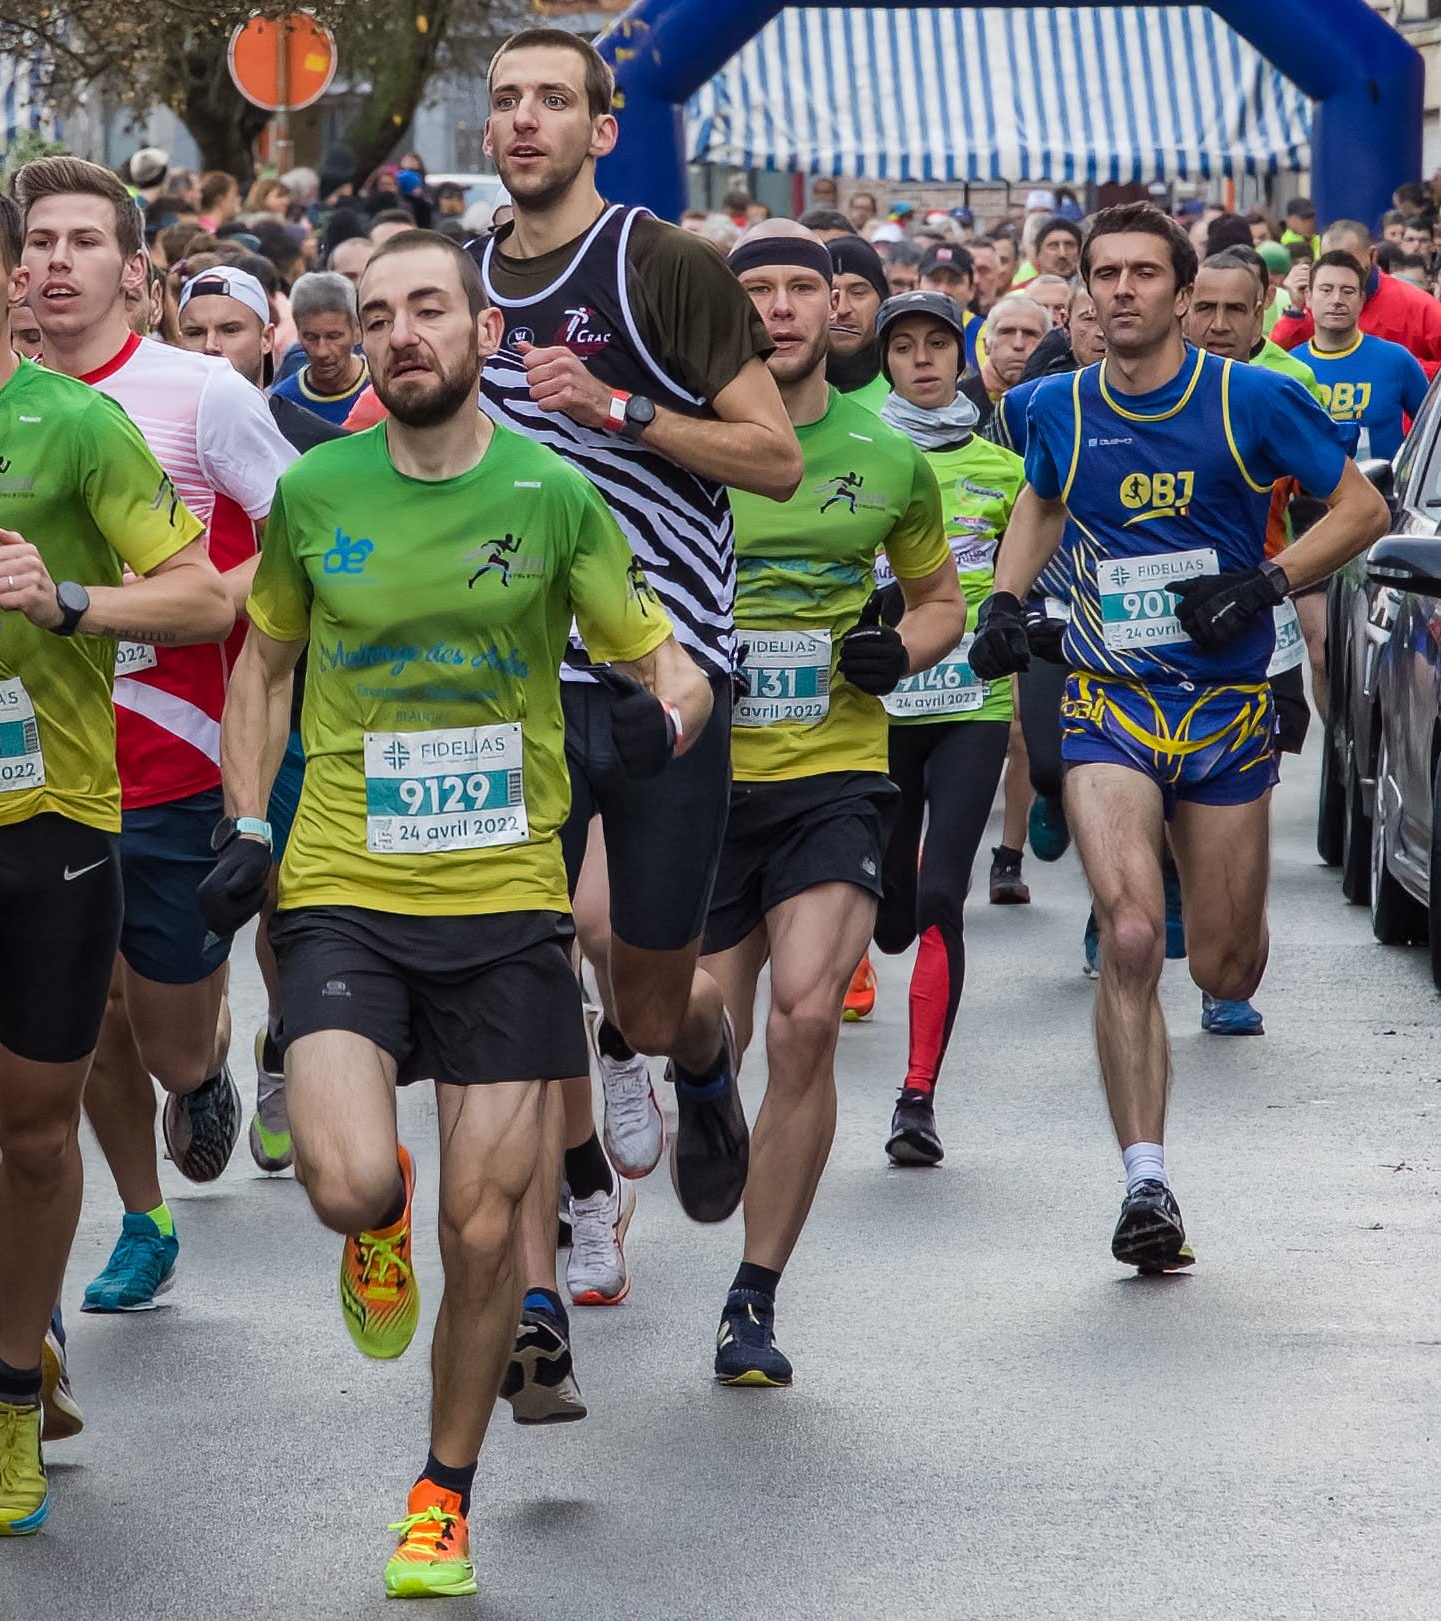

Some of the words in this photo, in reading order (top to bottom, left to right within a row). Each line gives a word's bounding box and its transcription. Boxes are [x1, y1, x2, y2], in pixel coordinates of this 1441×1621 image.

[1120, 471, 1195, 509] OBJ
[1138, 559, 1204, 577] FIDELIAS
[1123, 591, 1177, 620] 901
[1126, 627, 1141, 640] 24
[1146, 622, 1181, 636] avril
[116, 646, 147, 663] 022
[747, 669, 797, 697] 131
[740, 704, 779, 718] avril
[784, 704, 823, 717] 2022
[915, 695, 945, 708] avril
[421, 736, 506, 759] FIDELIAS
[399, 774, 491, 816] 9129
[400, 825, 420, 840] 24
[427, 820, 467, 840] avril
[474, 816, 520, 836] 2022
